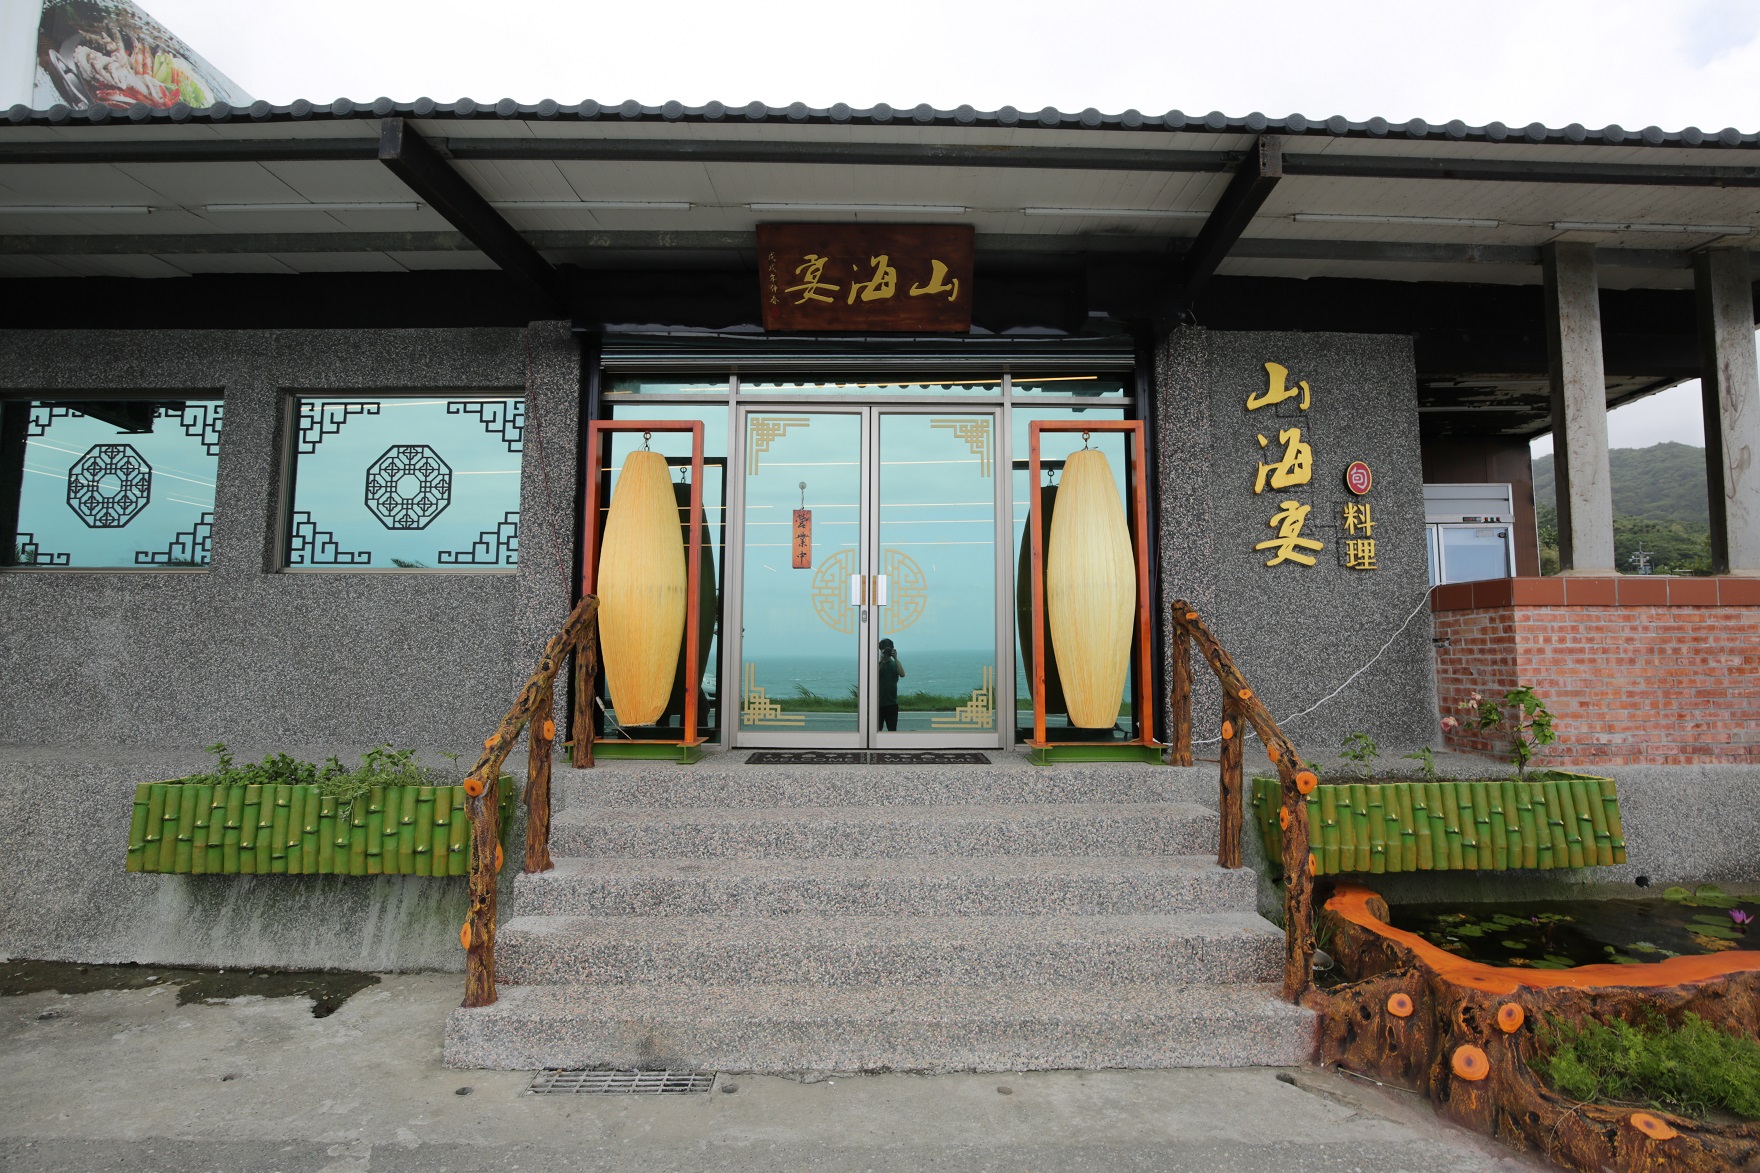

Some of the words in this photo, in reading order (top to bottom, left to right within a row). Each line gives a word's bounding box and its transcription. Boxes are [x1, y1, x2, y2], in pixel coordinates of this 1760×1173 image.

[1246, 361, 1324, 567] 山海宴
[795, 513, 810, 565] 營業中
